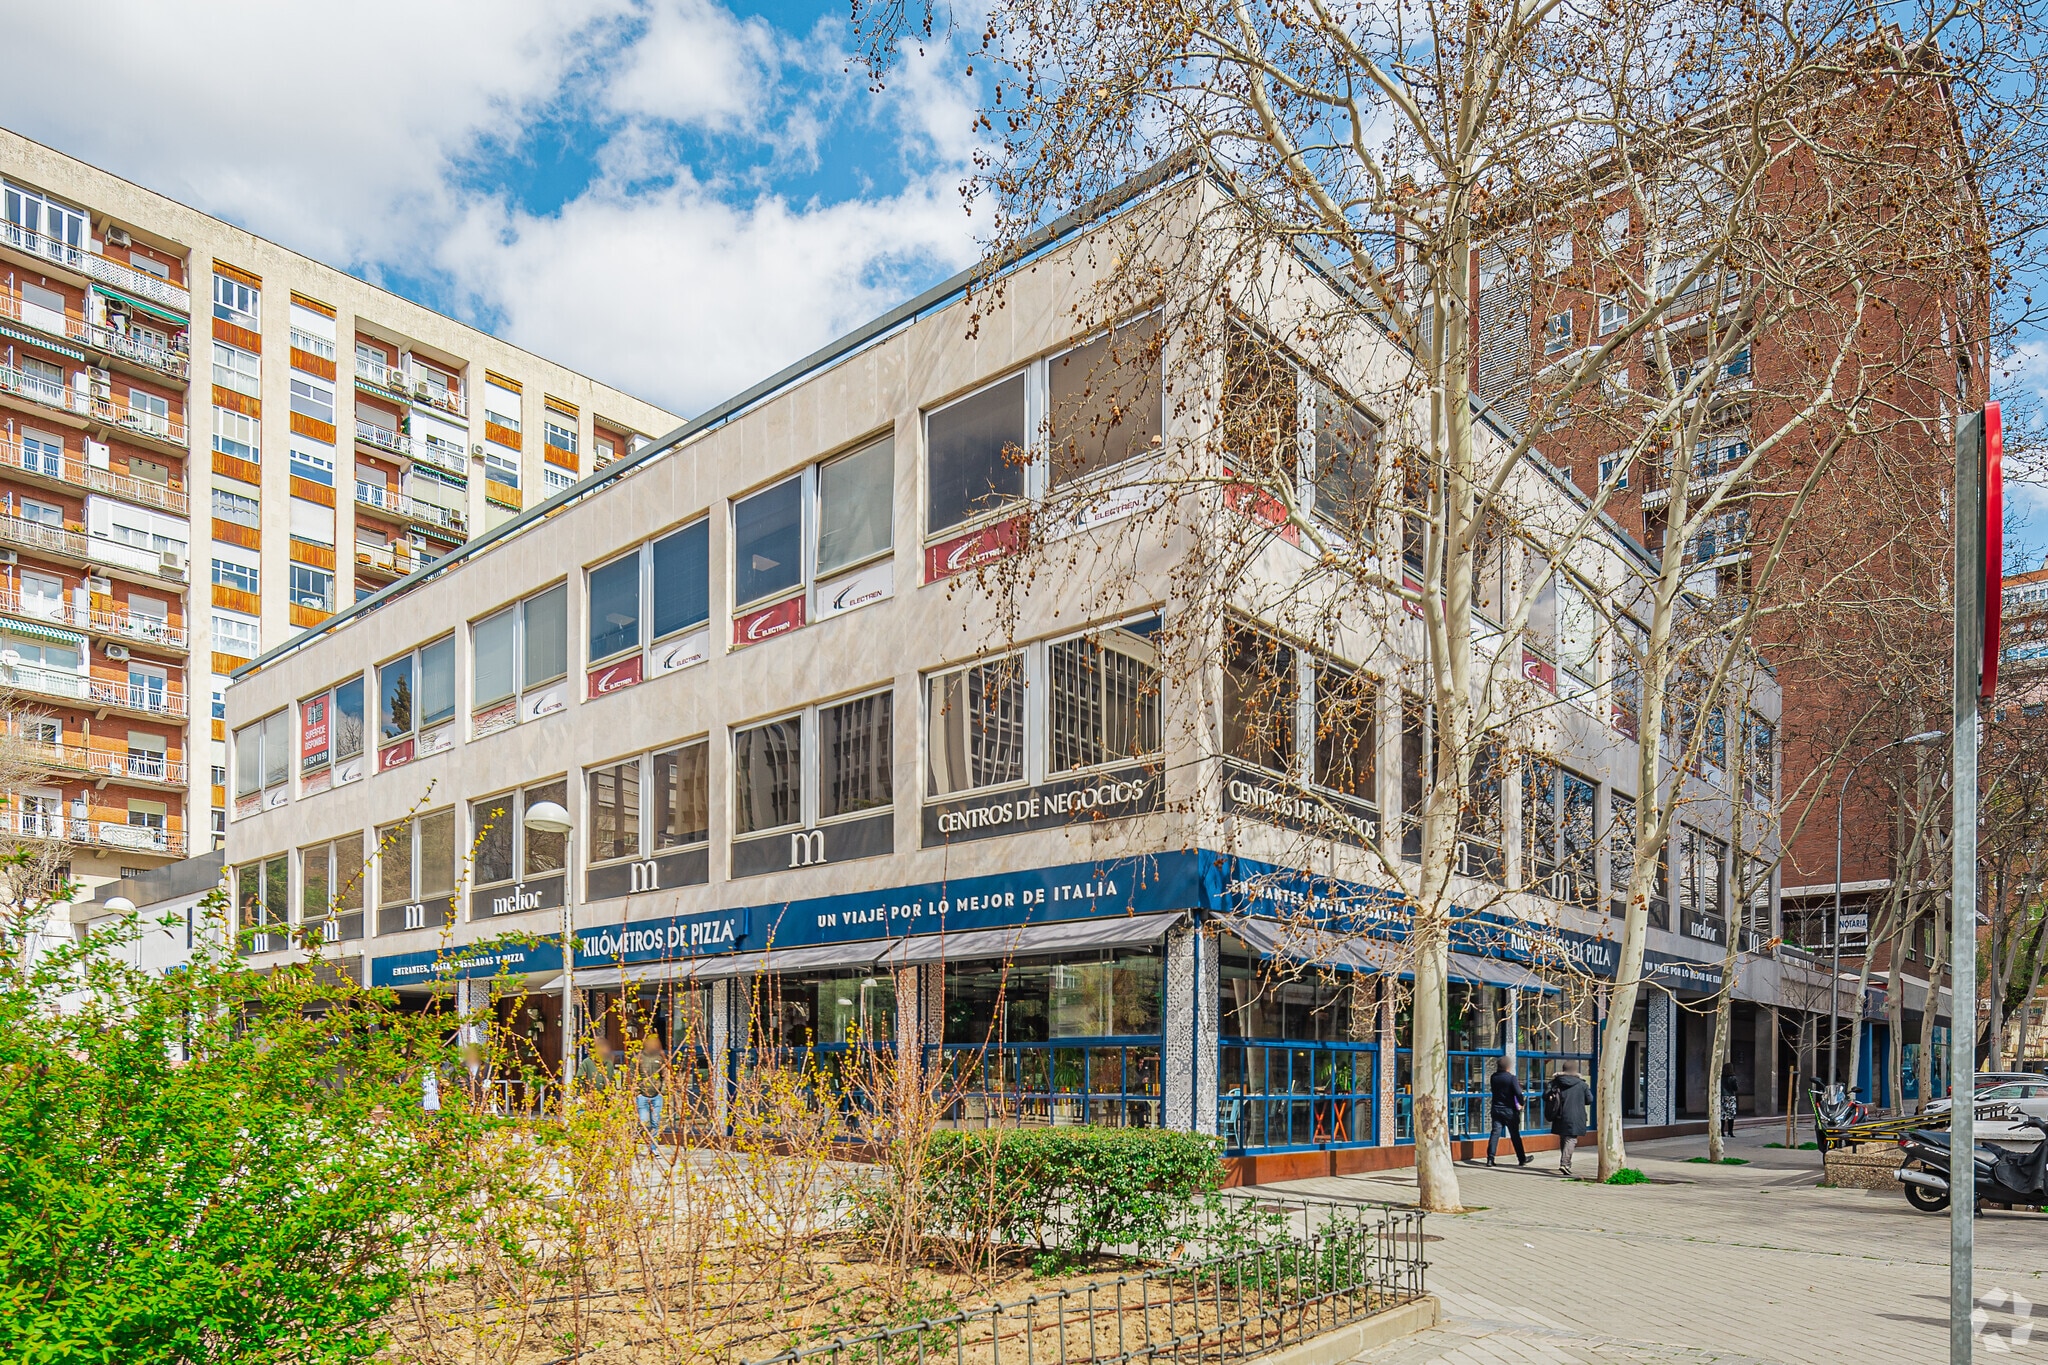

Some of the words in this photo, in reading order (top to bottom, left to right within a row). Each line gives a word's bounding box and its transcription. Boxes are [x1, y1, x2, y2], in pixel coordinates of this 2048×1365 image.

[1094, 500, 1140, 521] ELECTREN
[849, 590, 883, 606] ELECTREN
[762, 621, 791, 637] ELECTREN
[676, 653, 702, 667] ELECTREN
[937, 803, 1012, 833] CENTROS
[1016, 798, 1040, 821] DE
[1044, 779, 1143, 816] NEGOCIOS
[1228, 779, 1293, 818] CENTROS
[1294, 798, 1313, 823] DE
[788, 829, 827, 869] m
[629, 860, 660, 894] m
[492, 883, 543, 915] melior
[817, 913, 836, 928] UN
[842, 907, 884, 925] VIAJE
[891, 903, 922, 919] POR
[928, 900, 949, 916] LO
[956, 892, 1015, 912] MEJOR
[1023, 888, 1045, 905] DE
[1053, 880, 1118, 901] ITALIA
[404, 903, 425, 930] m
[1839, 918, 1866, 929] NOTARIA
[583, 928, 663, 958] KILÓMETROS
[667, 925, 687, 948] DE
[691, 920, 735, 946] PIZZA
[1586, 943, 1611, 967] PIZZA
